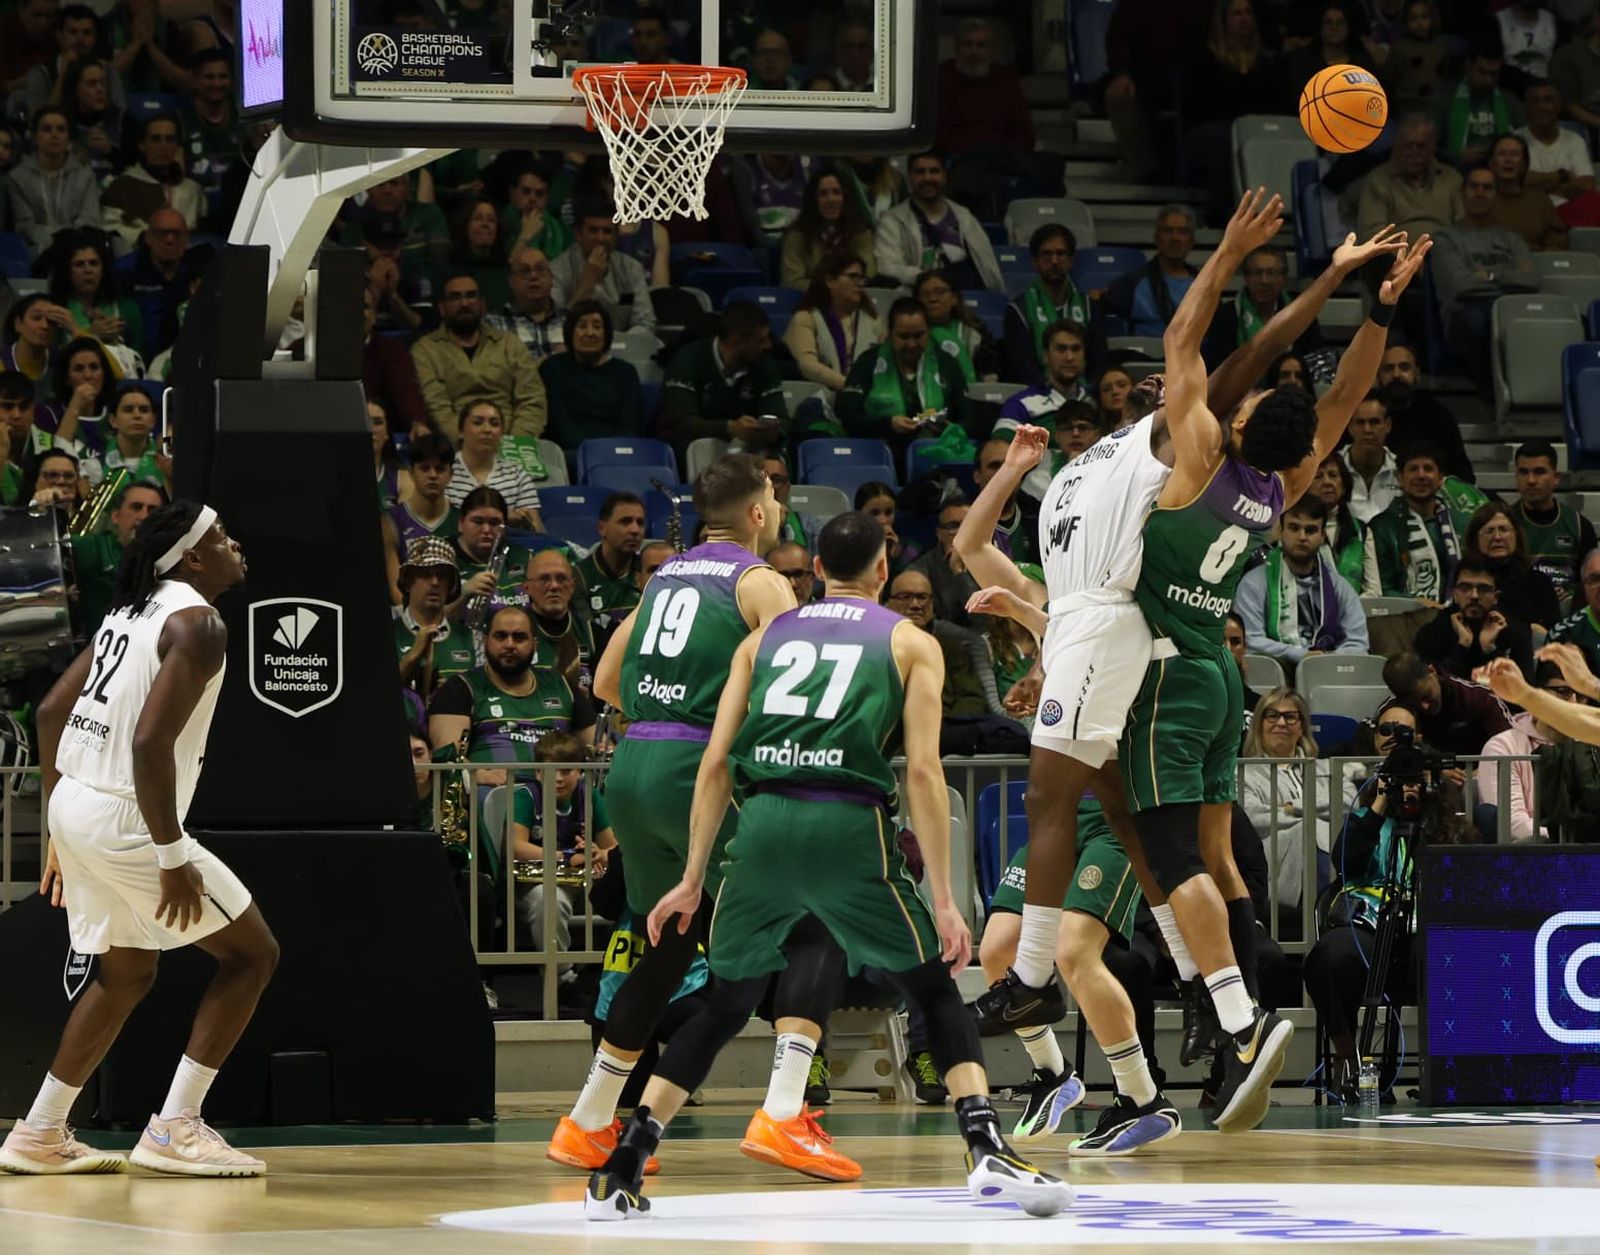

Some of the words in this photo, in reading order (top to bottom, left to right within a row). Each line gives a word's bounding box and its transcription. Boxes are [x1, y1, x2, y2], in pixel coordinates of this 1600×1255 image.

[401, 33, 475, 45] BASKETBALL
[401, 44, 484, 57] CHAMPIONS
[401, 56, 446, 66] LEAGUE
[401, 68, 436, 77] SEASON
[437, 69, 446, 78] X
[1232, 493, 1272, 524] TYSON
[1199, 523, 1249, 585] 0
[796, 603, 867, 621] DUARTE
[638, 586, 700, 658] 19
[80, 628, 129, 705] 32
[263, 653, 329, 667] Fundación
[273, 668, 321, 684] Unicaja
[761, 639, 864, 720] 27
[264, 681, 330, 692] Baloncesto
